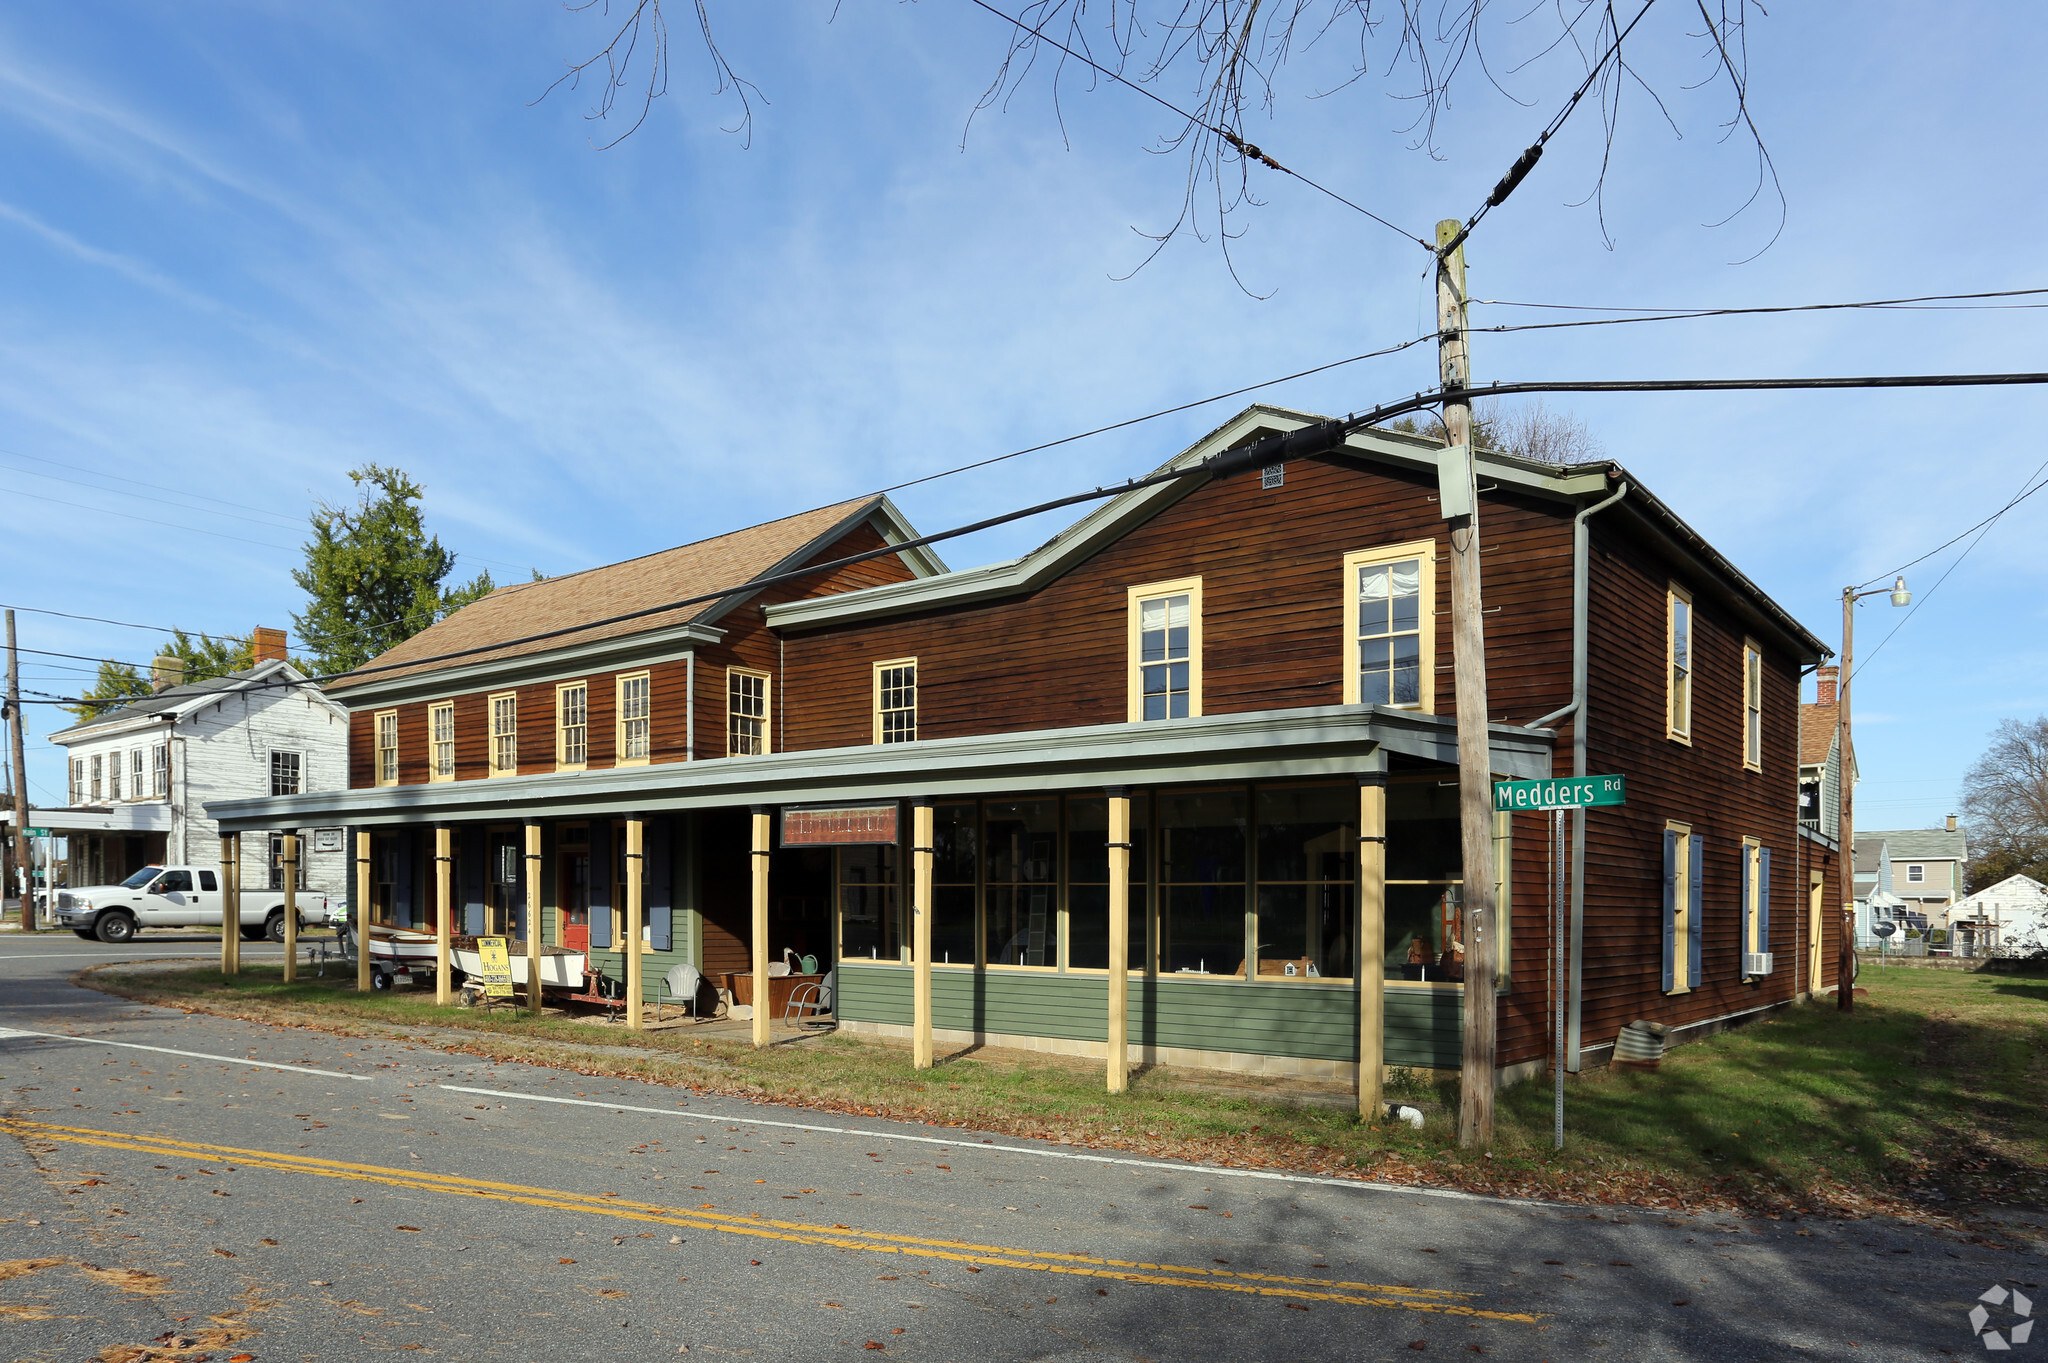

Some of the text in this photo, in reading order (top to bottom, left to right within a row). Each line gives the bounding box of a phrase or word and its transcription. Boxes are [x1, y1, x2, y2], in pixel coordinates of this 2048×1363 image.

[1498, 778, 1621, 807] Medders Rd
[483, 961, 509, 972] HOGANS
